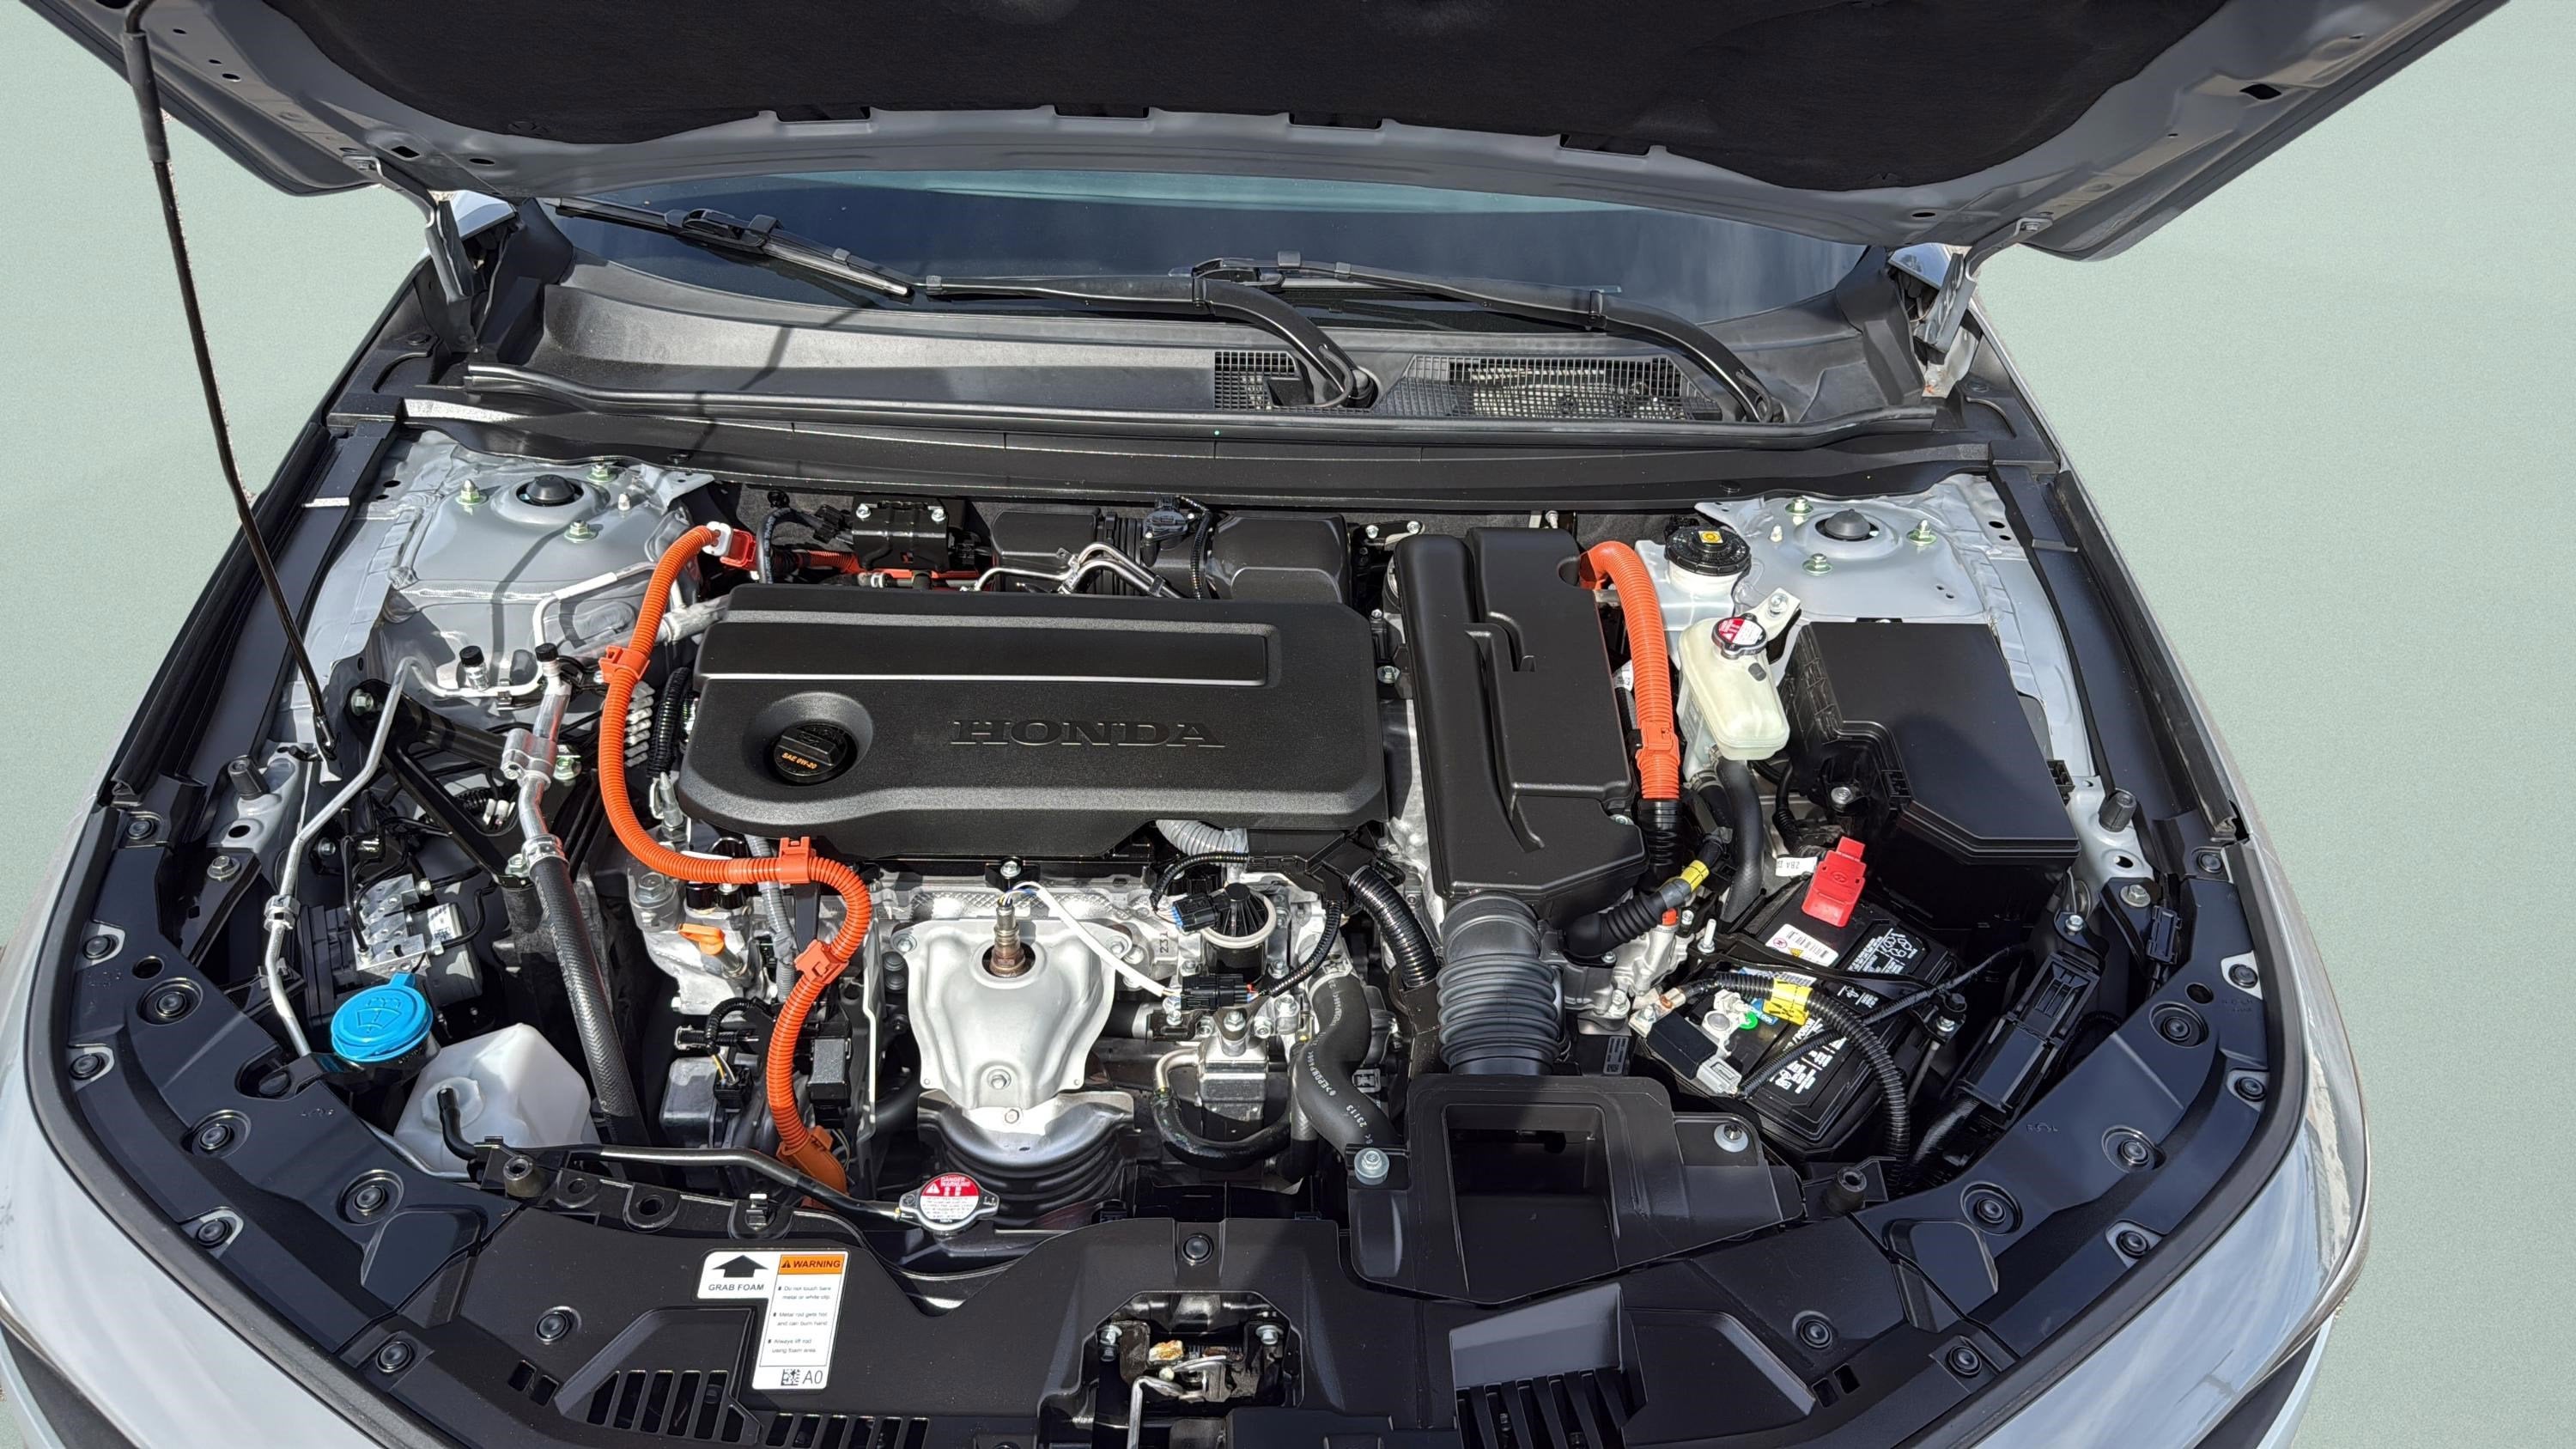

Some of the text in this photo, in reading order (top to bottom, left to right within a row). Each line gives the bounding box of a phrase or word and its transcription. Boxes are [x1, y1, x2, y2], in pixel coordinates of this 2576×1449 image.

[949, 719, 1226, 748] HONDA
[781, 752, 817, 770] SAE 0W-20
[1159, 931, 1169, 953] 231
[793, 1260, 841, 1269] WARNING
[802, 1370, 823, 1385] A0
